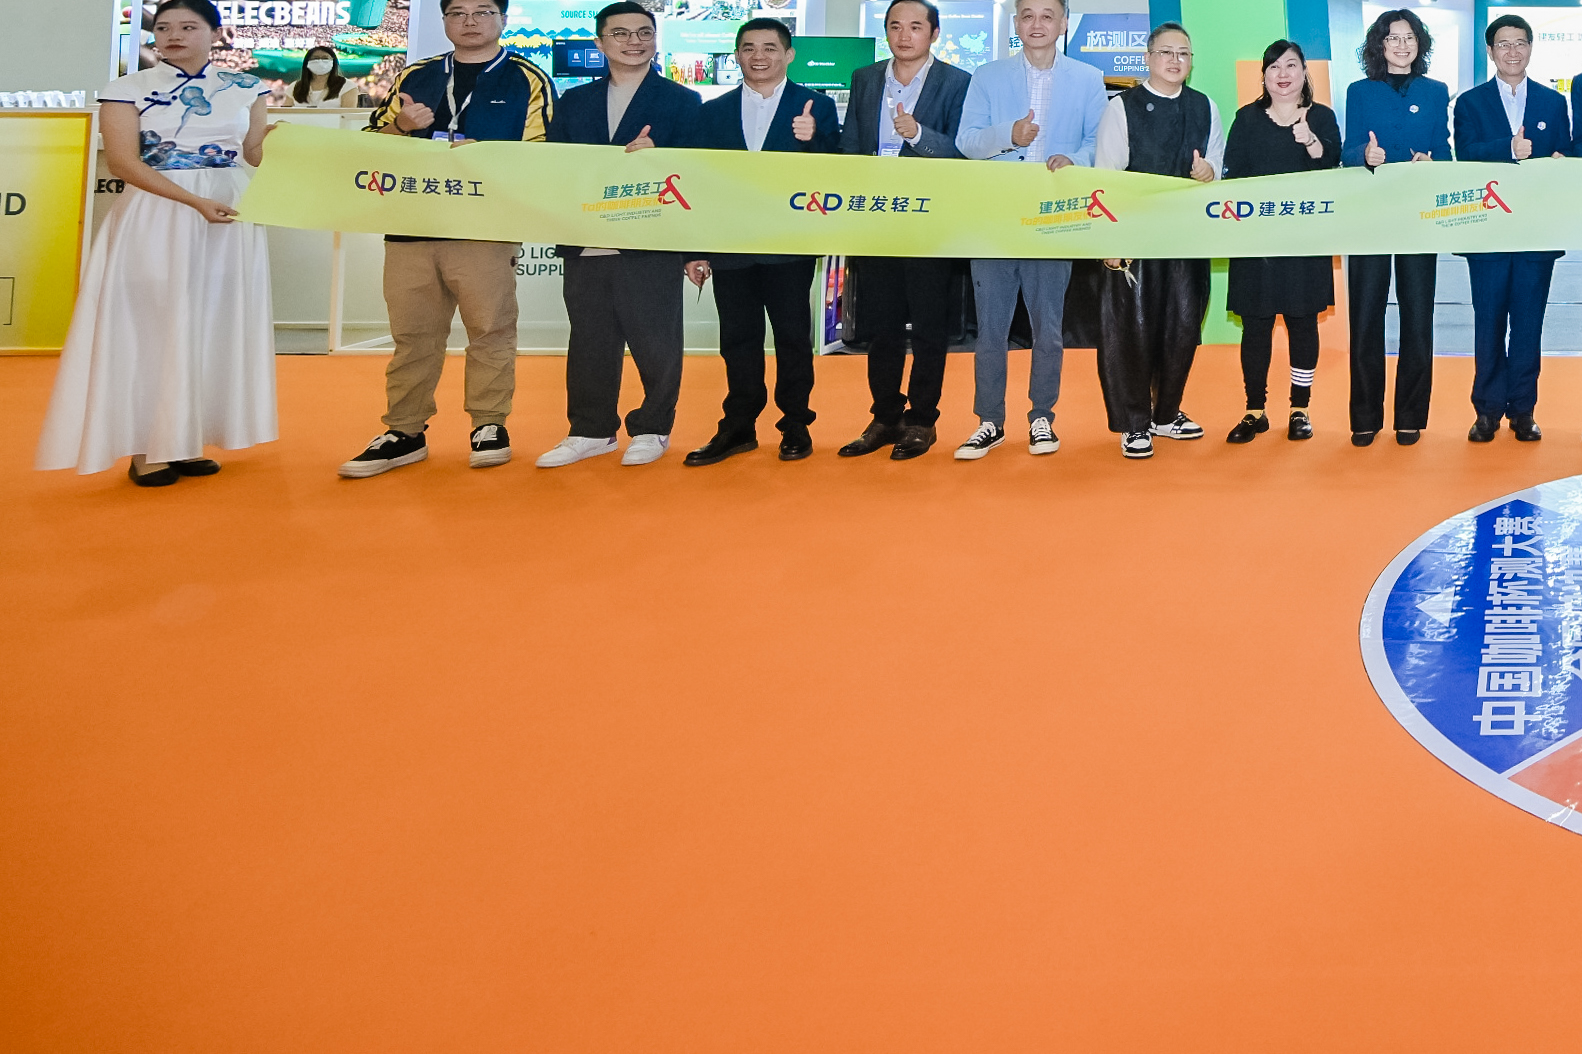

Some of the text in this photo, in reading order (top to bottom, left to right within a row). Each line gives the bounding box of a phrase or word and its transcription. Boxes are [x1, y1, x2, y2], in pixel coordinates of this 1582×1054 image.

[210, 0, 351, 26] ELECBEANS
[560, 10, 587, 19] SOURCE
[1086, 30, 1147, 50] 杯测区
[355, 170, 485, 197] C&D 建发轻工
[602, 181, 666, 199] 建发轻工
[0, 193, 26, 215] D
[789, 191, 931, 216] C&D 建发轻工
[1039, 196, 1091, 214] 建发轻工
[1435, 187, 1487, 208] 建发轻工
[1205, 199, 1335, 221] C&D 建发轻工
[531, 247, 561, 259] LIG
[1472, 517, 1544, 736] 中国咖啡杯测大赛
